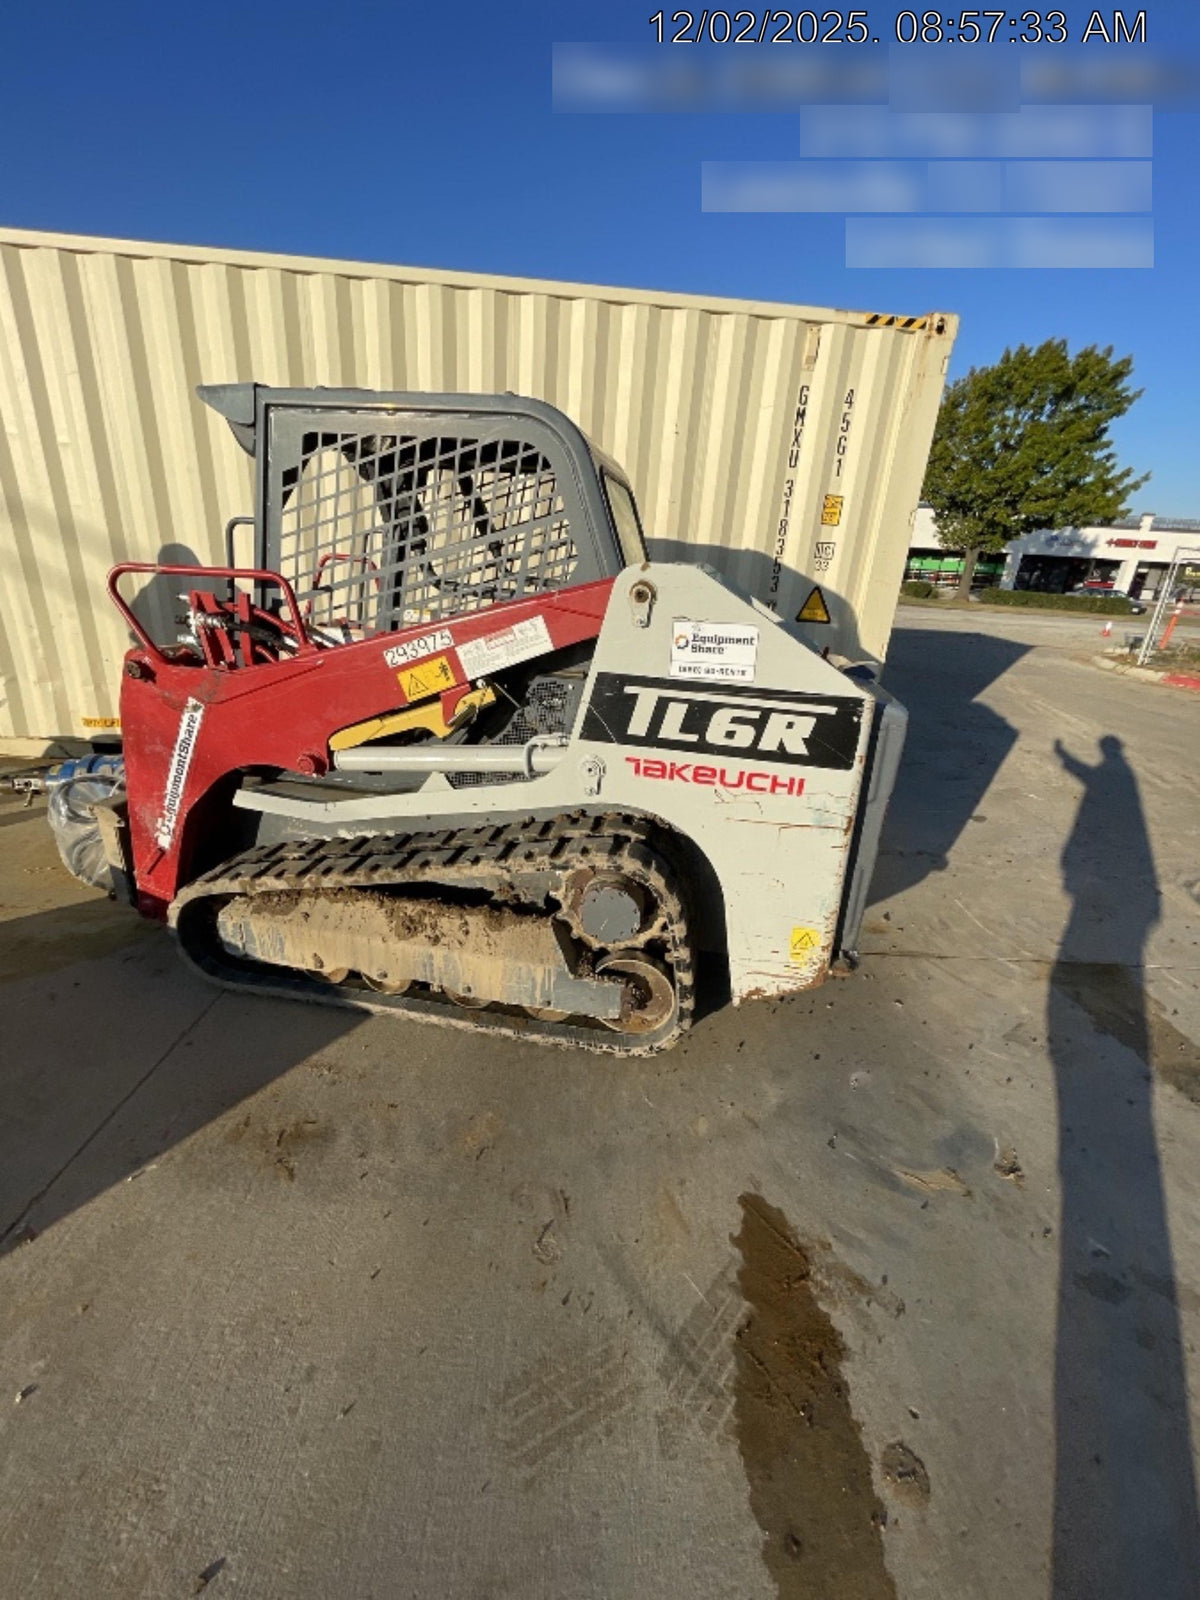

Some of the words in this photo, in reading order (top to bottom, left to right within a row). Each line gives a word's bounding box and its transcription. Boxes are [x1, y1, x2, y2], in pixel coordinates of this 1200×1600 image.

[385, 631, 452, 668] 293975
[691, 632, 756, 646] Equipment
[691, 643, 725, 655] Share
[624, 686, 838, 755] TL6R
